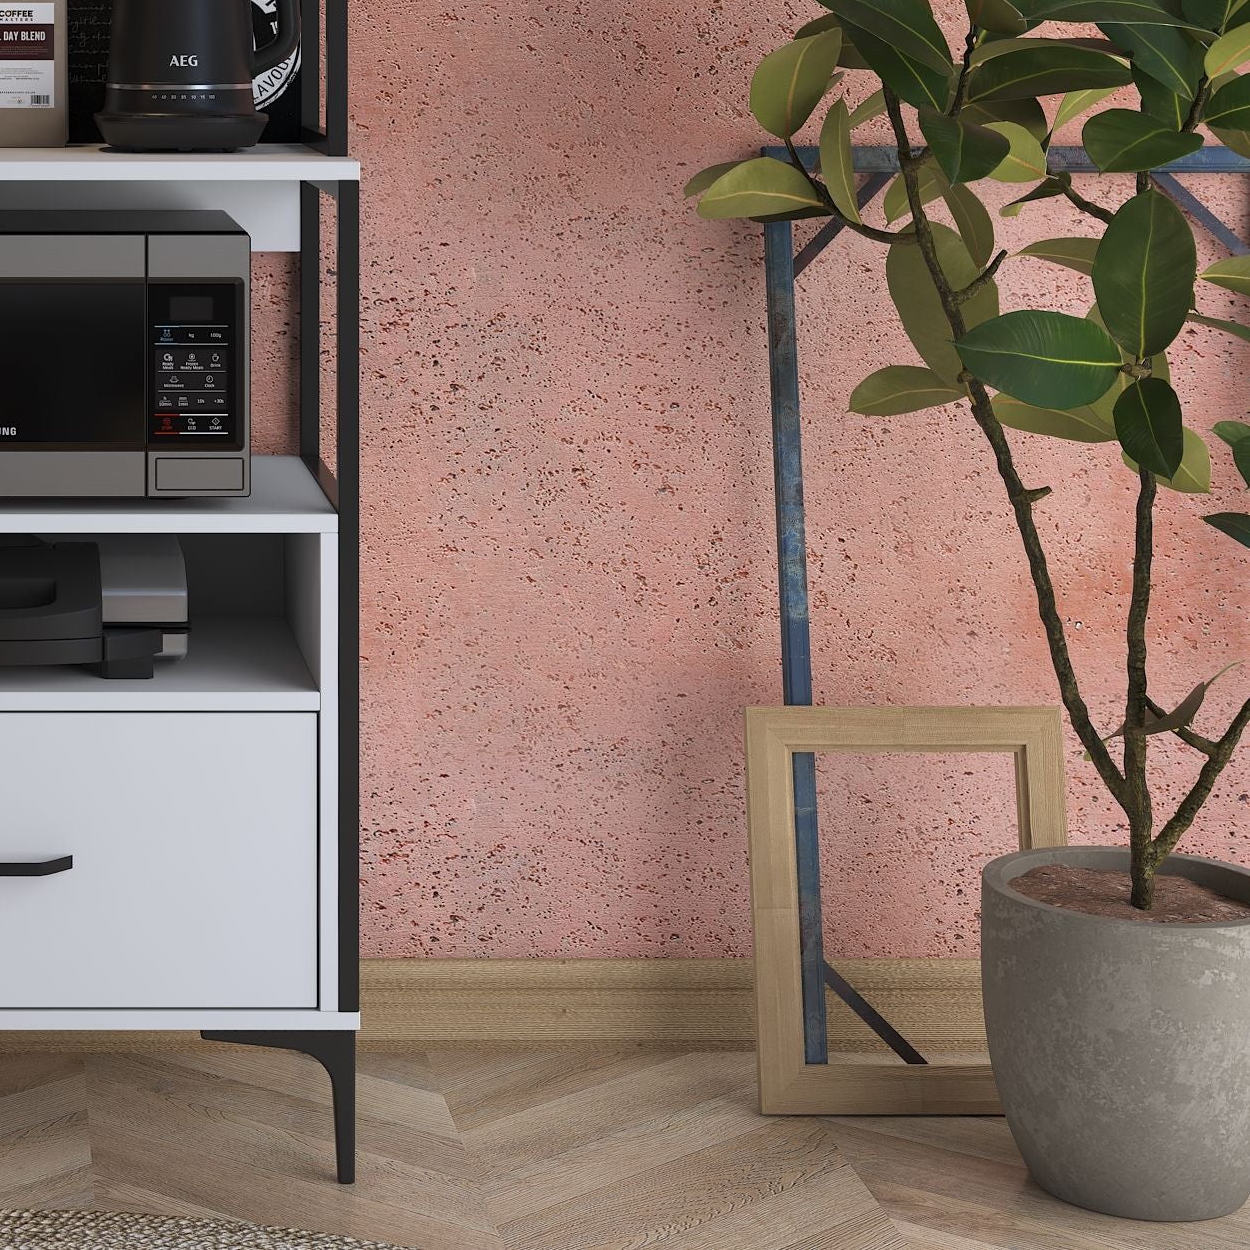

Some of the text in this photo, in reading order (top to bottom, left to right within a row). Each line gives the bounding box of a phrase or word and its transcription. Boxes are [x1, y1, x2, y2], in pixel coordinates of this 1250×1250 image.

[3, 31, 19, 41] DAY
[21, 31, 46, 41] BLEND
[169, 55, 198, 67] AEG
